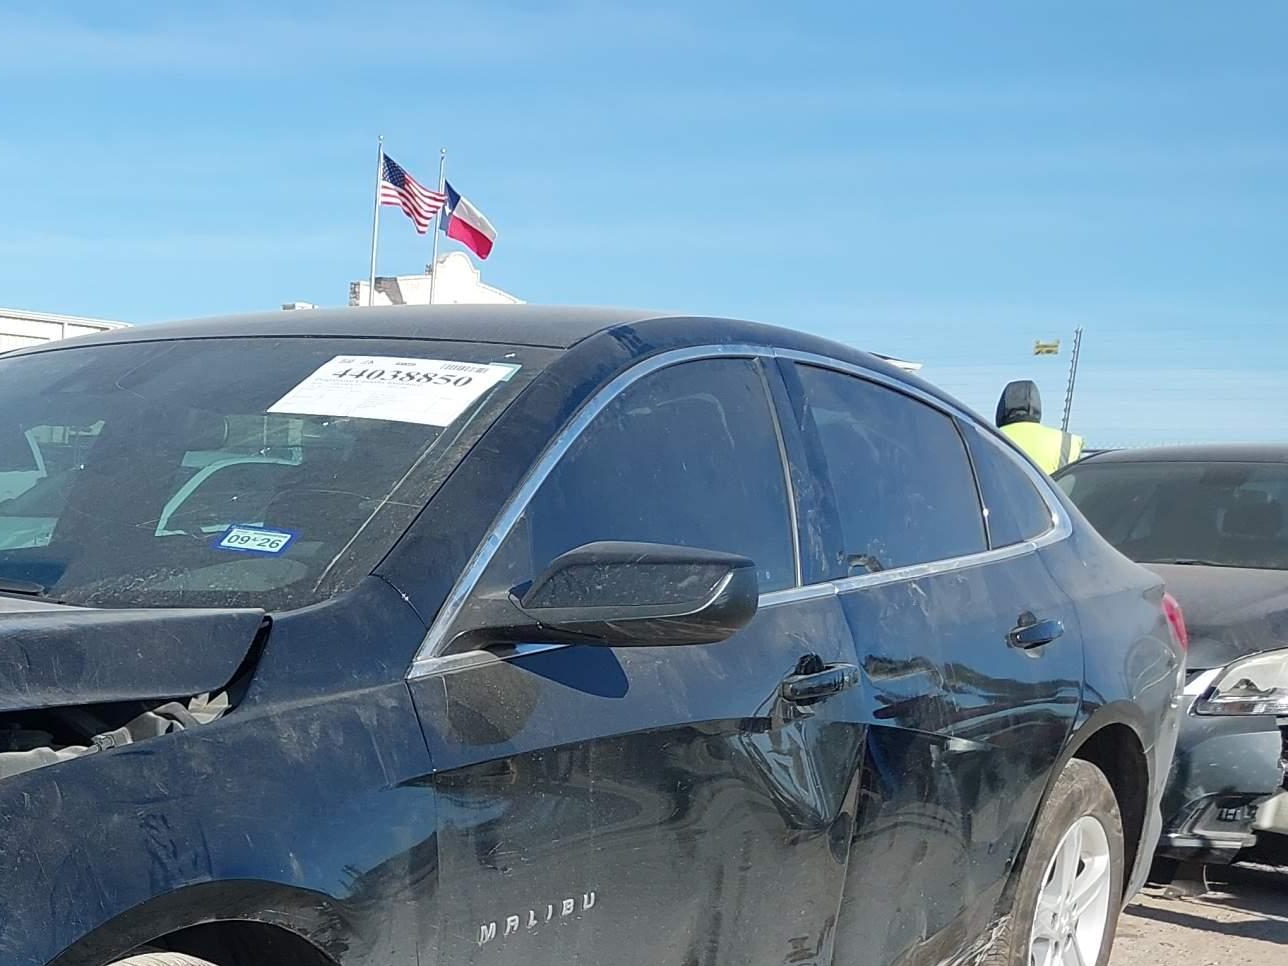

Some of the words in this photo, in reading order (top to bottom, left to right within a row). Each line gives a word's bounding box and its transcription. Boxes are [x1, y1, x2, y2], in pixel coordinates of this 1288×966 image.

[332, 367, 473, 387] 44038850
[227, 534, 251, 545] 09
[256, 537, 283, 549] 26
[478, 892, 596, 946] MALIBU
